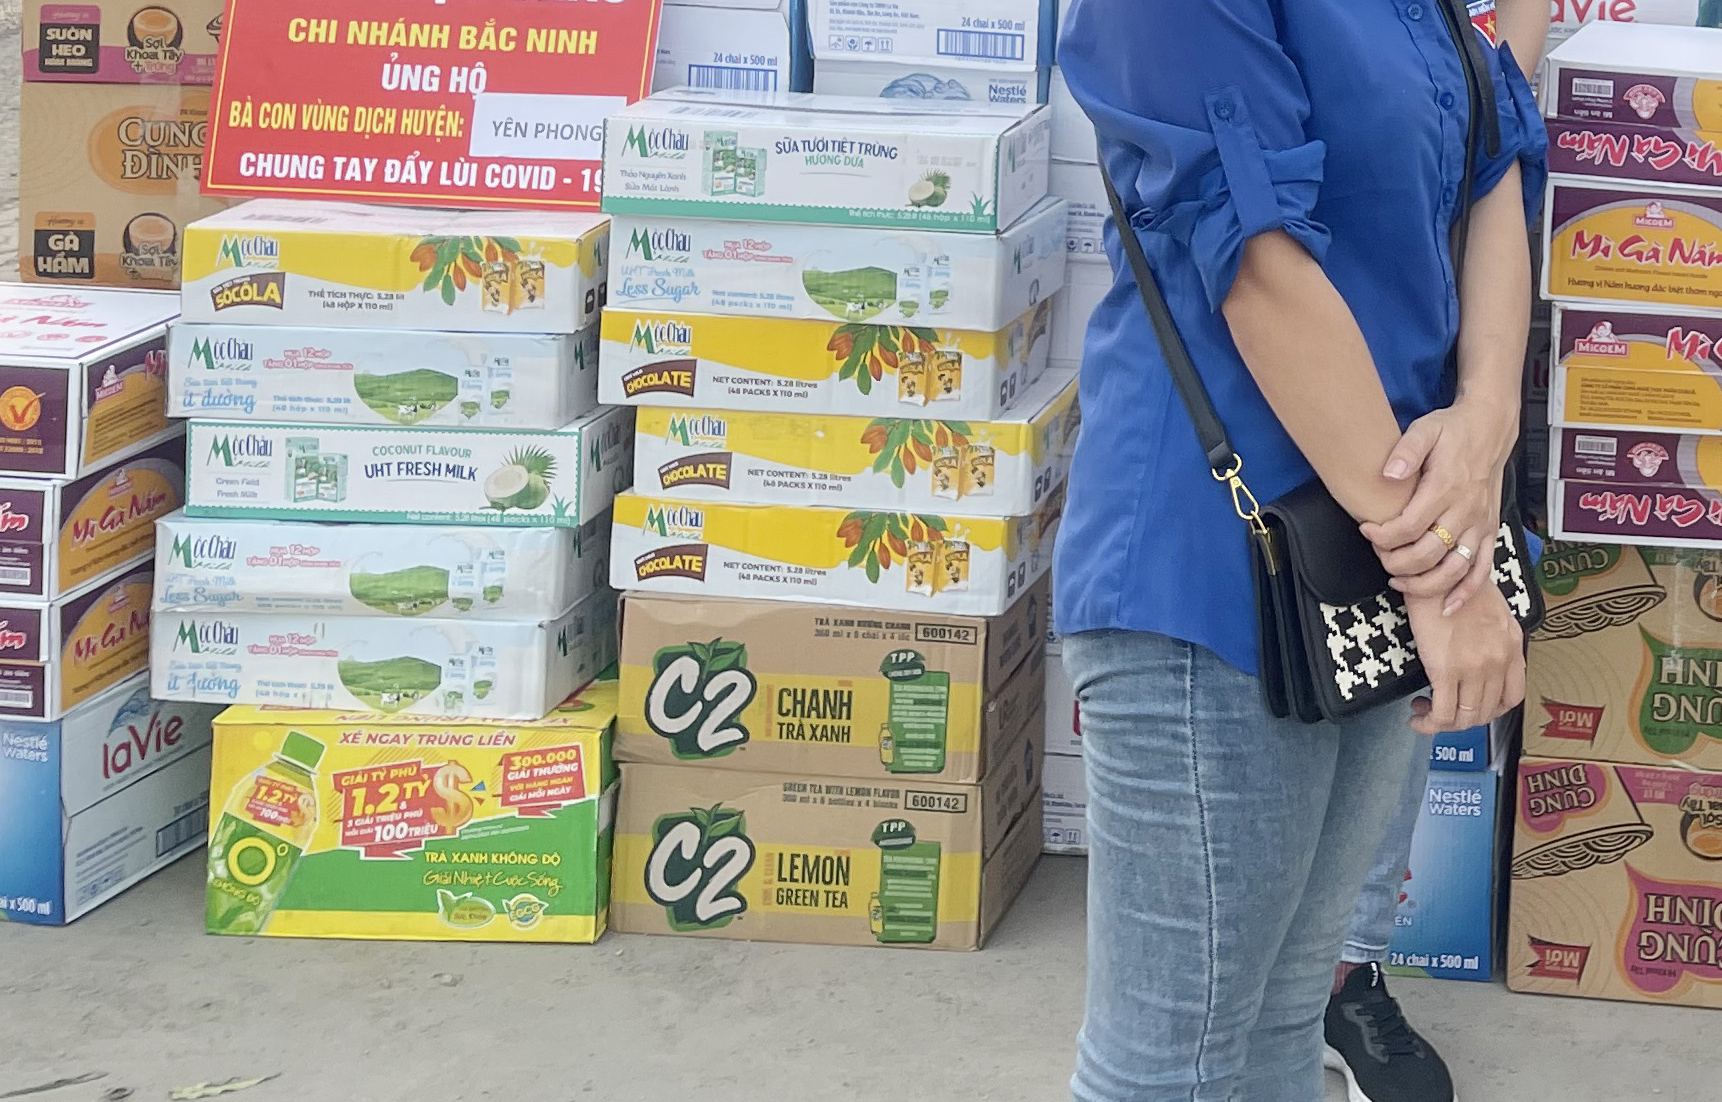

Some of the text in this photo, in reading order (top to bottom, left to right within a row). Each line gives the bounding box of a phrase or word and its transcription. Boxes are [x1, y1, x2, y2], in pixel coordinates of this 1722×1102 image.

[288, 17, 598, 56] CHI NHÁNH BẮC NINH
[52, 44, 86, 57] HEO
[381, 52, 488, 98] ỦNG HỘ
[988, 84, 1027, 97] Nestlé
[228, 95, 465, 143] BÀ CON VÙNG DỊCH HUYỆN:
[492, 114, 602, 142] YÊN PHONG
[775, 136, 800, 155] SỮA
[858, 140, 899, 160] TRÙNG
[1556, 130, 1631, 167] Nấm
[1630, 134, 1683, 171] Gà
[239, 151, 325, 181] CHUNG
[333, 156, 379, 184] TAY
[383, 149, 433, 186] ĐẨY
[439, 159, 478, 188] LÙI
[484, 165, 555, 191] COVID
[1635, 216, 1674, 228] MICOEM
[1570, 229, 1613, 262] Mì
[1616, 233, 1663, 266] Gà
[616, 277, 649, 298] Less
[652, 277, 701, 303] Sugar
[1578, 342, 1627, 355] MICOEM
[1666, 325, 1712, 362] Mì
[626, 370, 692, 394] CHOCOLATE
[201, 387, 258, 415] đường
[372, 445, 473, 459] COCONUT FLAVOUR
[242, 478, 260, 487] Field
[364, 461, 477, 482] UHT FRESH MILK
[663, 463, 728, 486] CHOCOLATE
[748, 469, 765, 478] NET
[766, 470, 809, 480] CONTENT:
[217, 490, 258, 499] Fresh Milk
[1580, 491, 1653, 525] Nấm
[1655, 494, 1706, 528] Gà
[638, 554, 703, 577] CHOCOLATE
[922, 626, 970, 641] 600142
[890, 650, 916, 664] TPP
[646, 652, 757, 754] C2
[777, 686, 853, 720] CHANH
[2, 732, 49, 751] Nestlé
[339, 729, 517, 747] XÉ NGAY TRÚNG LIỀN
[777, 718, 851, 743] TRÀ XANH
[2, 747, 49, 762] Waters
[102, 710, 184, 779] laVie
[1435, 746, 1474, 763] 500 ml
[509, 748, 577, 771] 300.000
[351, 782, 400, 817] 1.2
[783, 782, 808, 793] GREEN
[810, 784, 823, 794] TEA
[846, 786, 871, 797] LEMON
[1429, 788, 1482, 804] Nestlé
[911, 794, 960, 810] 600142
[1429, 802, 1482, 817] Waters
[374, 822, 408, 842] 100
[882, 821, 907, 834] TPP
[425, 850, 561, 867] TRÀ XANH KHÔNG ĐỘ
[777, 852, 850, 887] LEMON
[646, 819, 755, 923] C2
[776, 887, 849, 909] GREEN TEA
[1391, 952, 1479, 971] 24 chai x 500 ml
